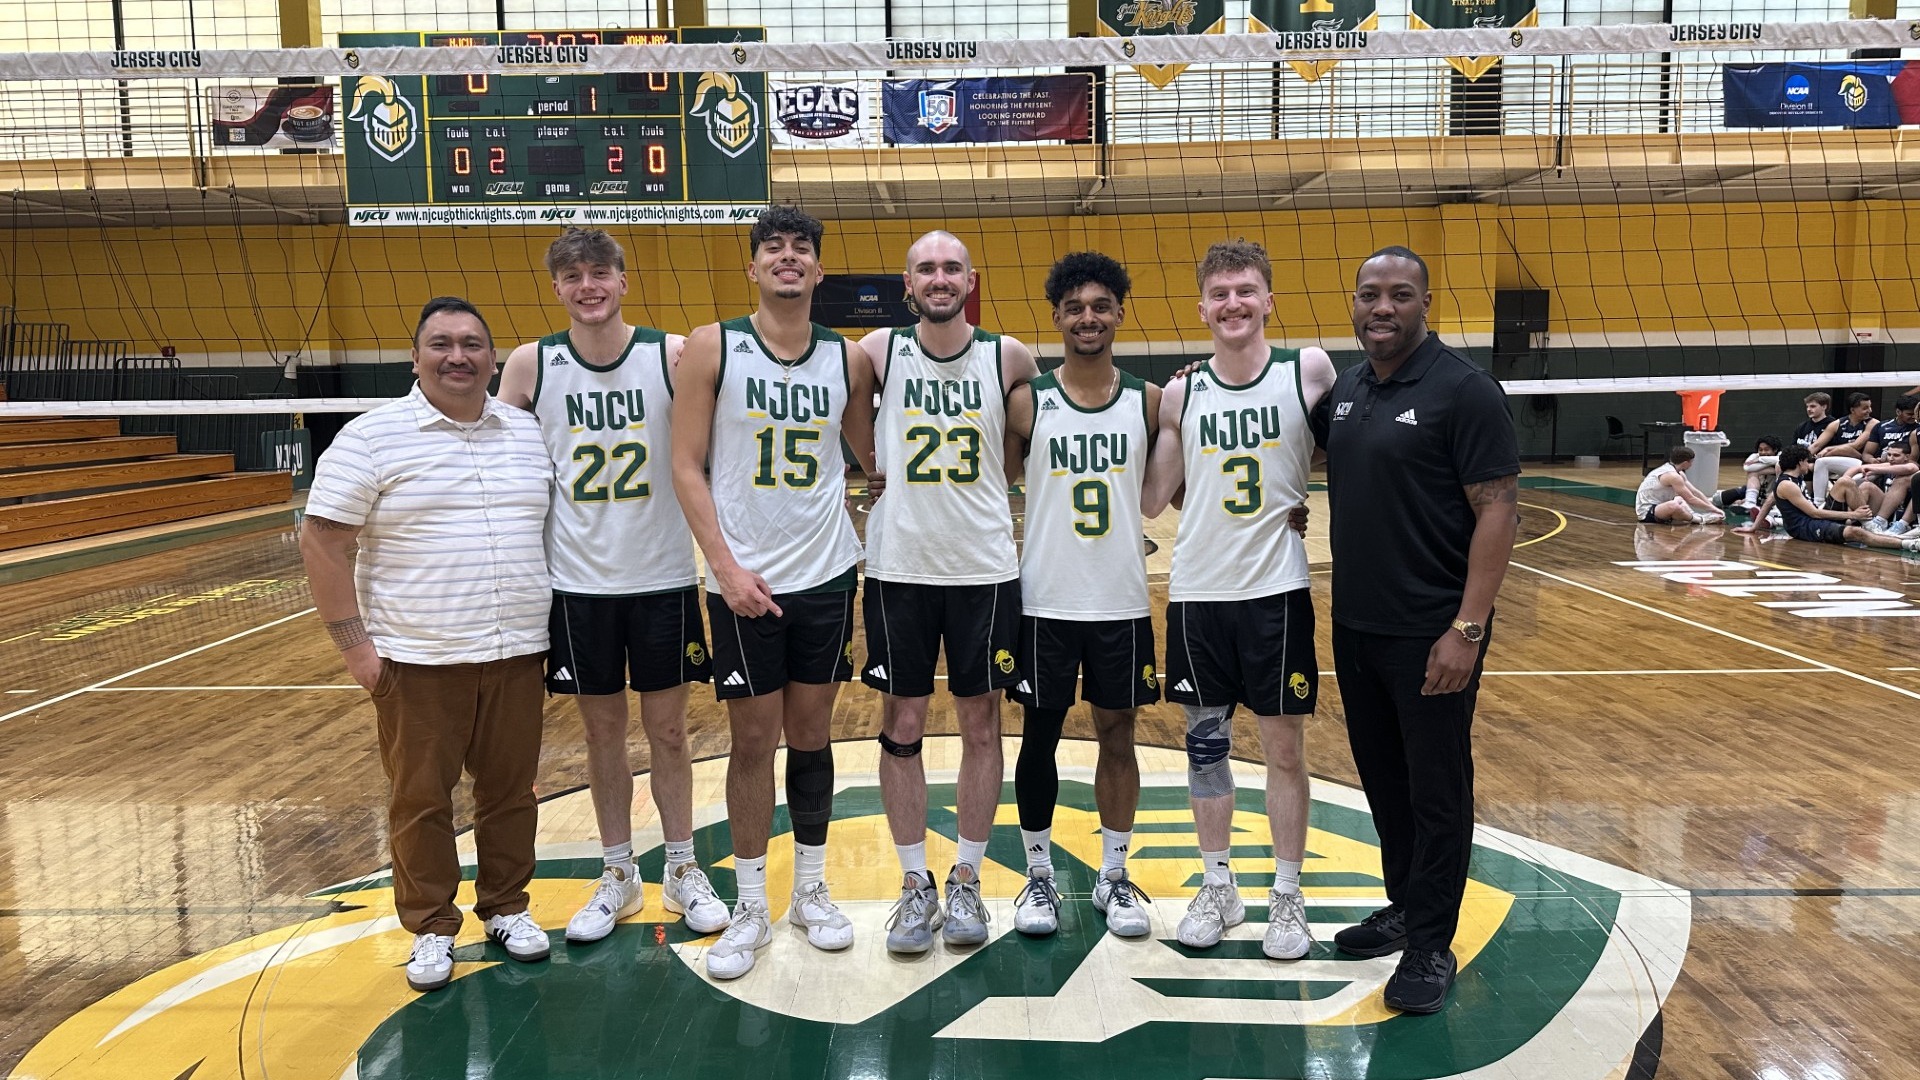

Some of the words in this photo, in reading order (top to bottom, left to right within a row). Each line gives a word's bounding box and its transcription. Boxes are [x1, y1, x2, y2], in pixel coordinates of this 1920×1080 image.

[1275, 32, 1332, 50] JERSEY
[1335, 31, 1368, 49] CITY
[1669, 24, 1727, 42] JERSEY
[1729, 23, 1762, 39] CITY
[111, 51, 166, 68] JERSEY
[169, 50, 202, 67] CITY
[497, 46, 553, 64] JERSEY
[556, 45, 589, 63] CITY
[886, 41, 942, 59] JERSEY
[945, 41, 977, 59] CITY
[590, 87, 597, 111] 1
[1786, 87, 1810, 95] NCAA
[537, 100, 569, 114] period
[778, 87, 857, 117] ECAC
[1780, 102, 1807, 111] Division
[978, 112, 1011, 120] LOOKING
[1012, 111, 1046, 119] FORWARD
[446, 127, 470, 138] fouls
[537, 125, 570, 138] player
[641, 125, 665, 137] fouls
[454, 147, 471, 175] 0
[489, 147, 505, 174] 2
[608, 146, 623, 173] 2
[648, 145, 666, 173] 0
[451, 184, 470, 193] won
[485, 181, 525, 195] NJCU
[545, 183, 570, 195] game
[589, 180, 629, 195] NJCU
[645, 183, 665, 193] won
[353, 209, 391, 223] NJCU
[395, 207, 536, 223] www.njcugothicknights.com
[540, 208, 577, 222] NJCU
[583, 206, 724, 222] www.njcugothicknights.com
[860, 294, 879, 302] NCAA
[854, 307, 877, 315] Division
[746, 376, 830, 423] NJCU
[904, 378, 982, 417] NJCU
[565, 388, 646, 431] NJCU
[1200, 405, 1281, 451] NJCU
[1395, 415, 1418, 427] adidas
[753, 425, 821, 489] 15
[905, 424, 982, 485] 23
[1050, 433, 1127, 474] NJCU
[571, 440, 650, 503] 22
[1221, 453, 1265, 517] 3
[1072, 477, 1112, 539] 9
